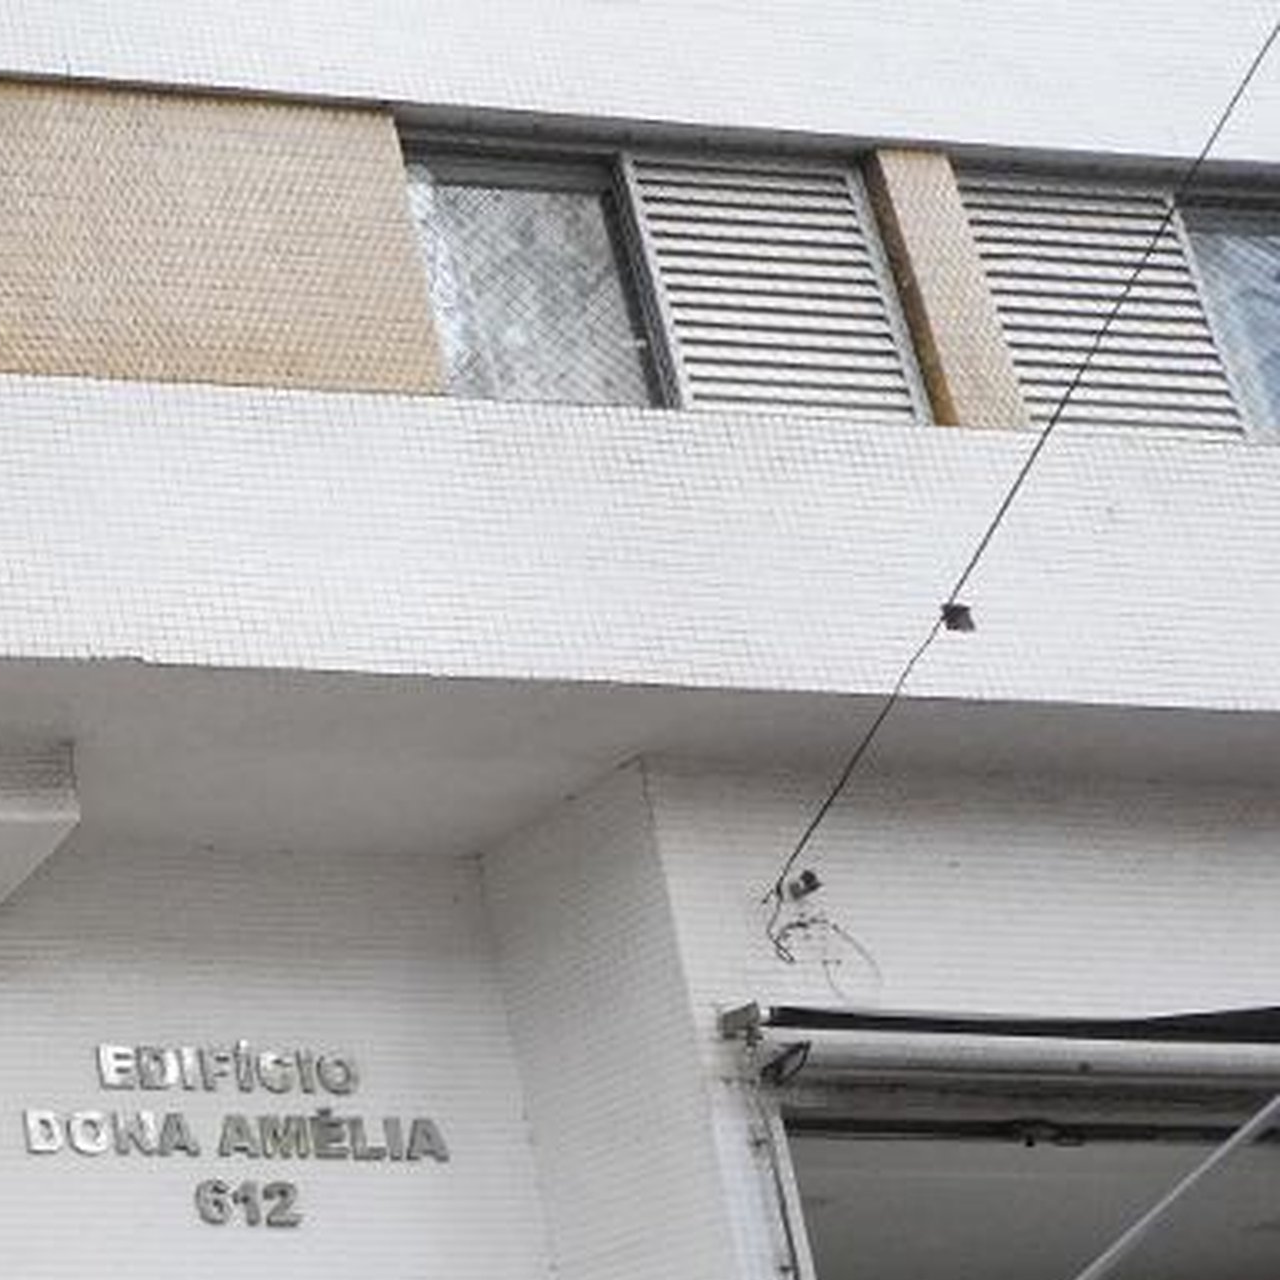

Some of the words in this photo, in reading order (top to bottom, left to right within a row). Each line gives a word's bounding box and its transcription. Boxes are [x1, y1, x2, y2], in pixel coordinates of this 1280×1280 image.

[96, 1040, 360, 1095] EDIFÍCIO
[23, 1108, 200, 1157] DONA
[218, 1108, 450, 1162] AMÉLIA
[194, 1179, 302, 1228] 612
